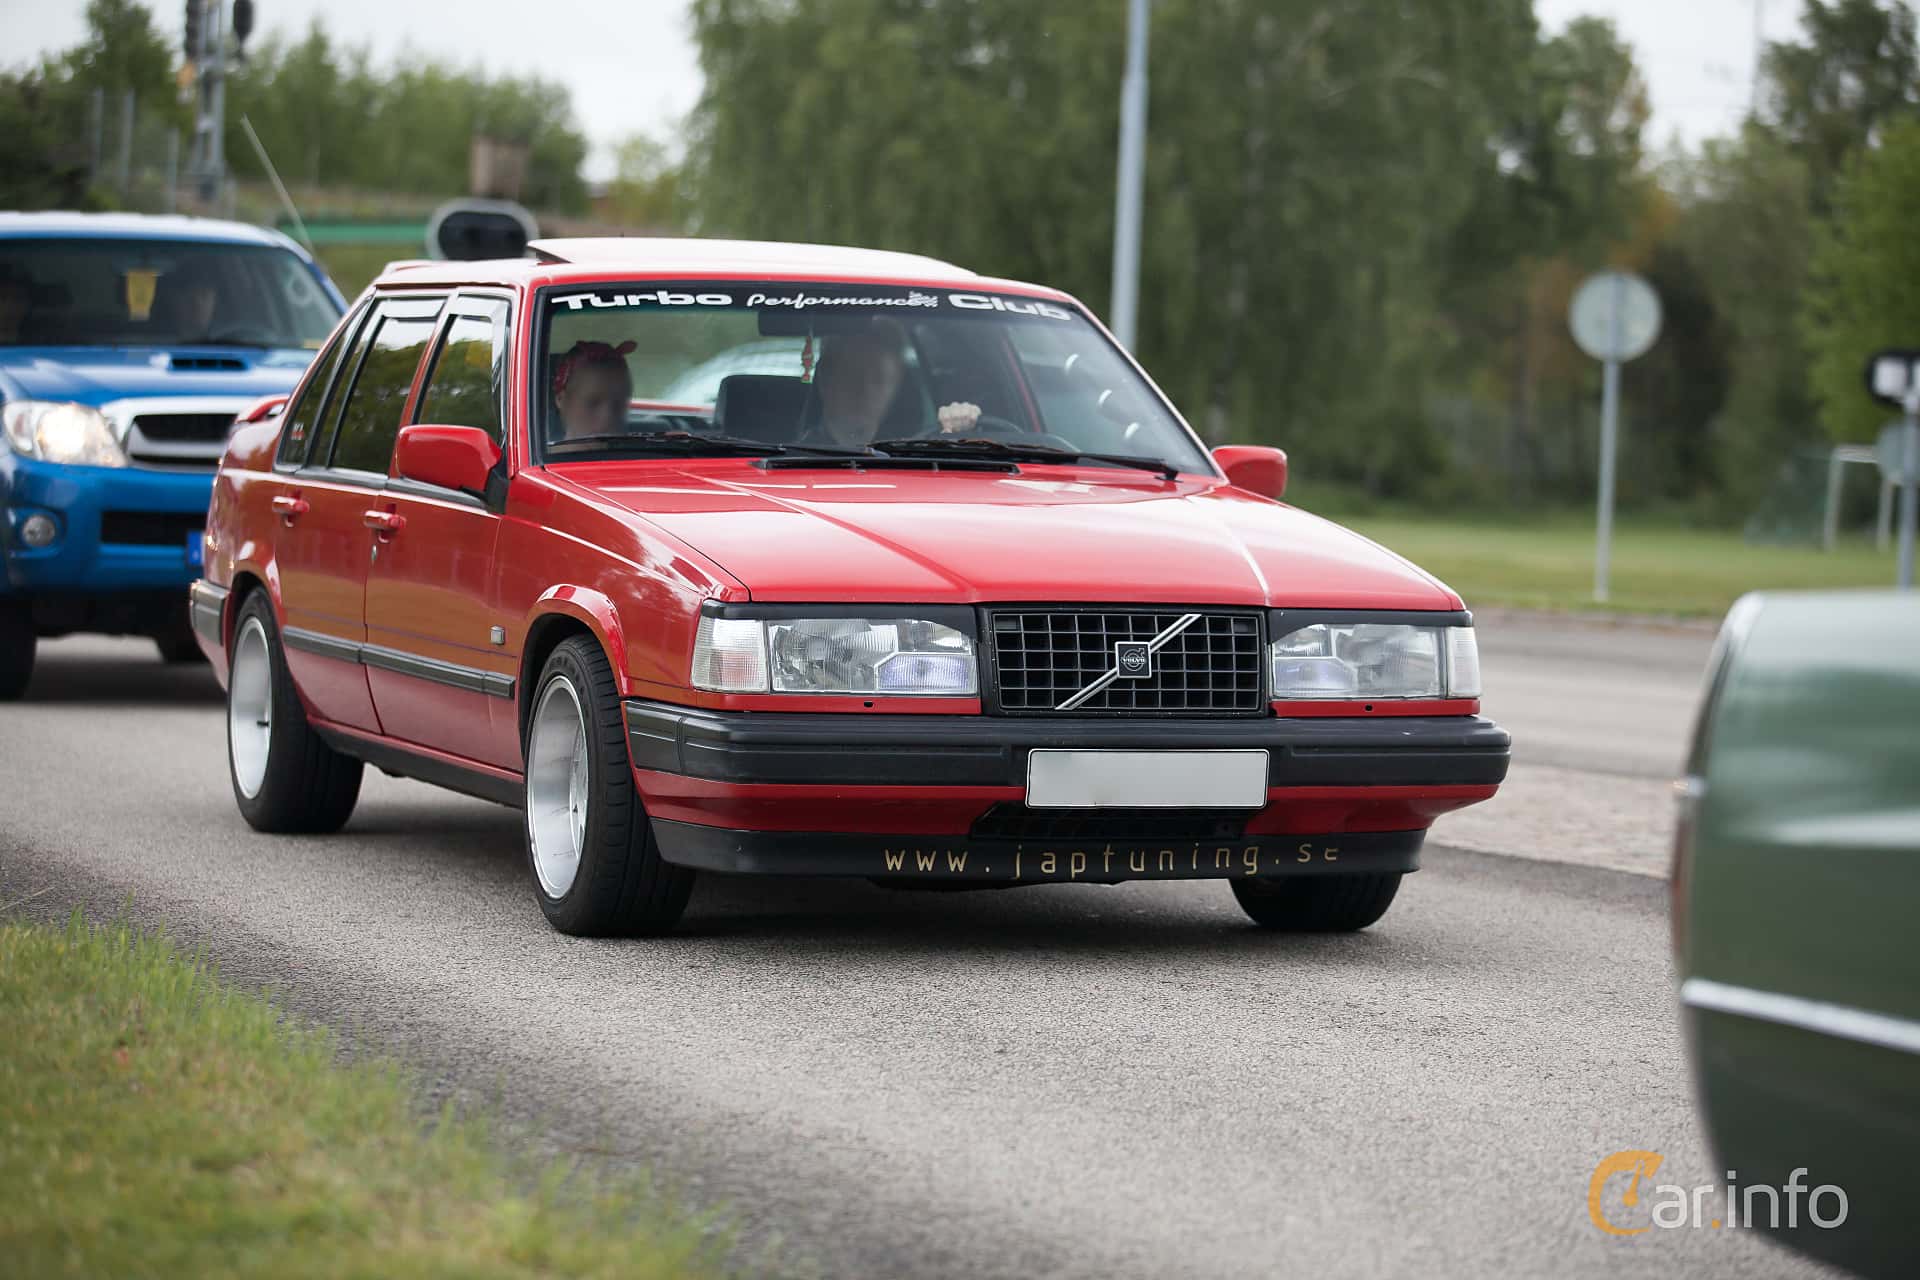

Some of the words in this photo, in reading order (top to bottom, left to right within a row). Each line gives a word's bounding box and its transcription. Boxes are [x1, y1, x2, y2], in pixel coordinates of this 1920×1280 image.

[551, 291, 733, 310] Turbo
[746, 292, 924, 309] Performance
[948, 294, 1071, 321] Club
